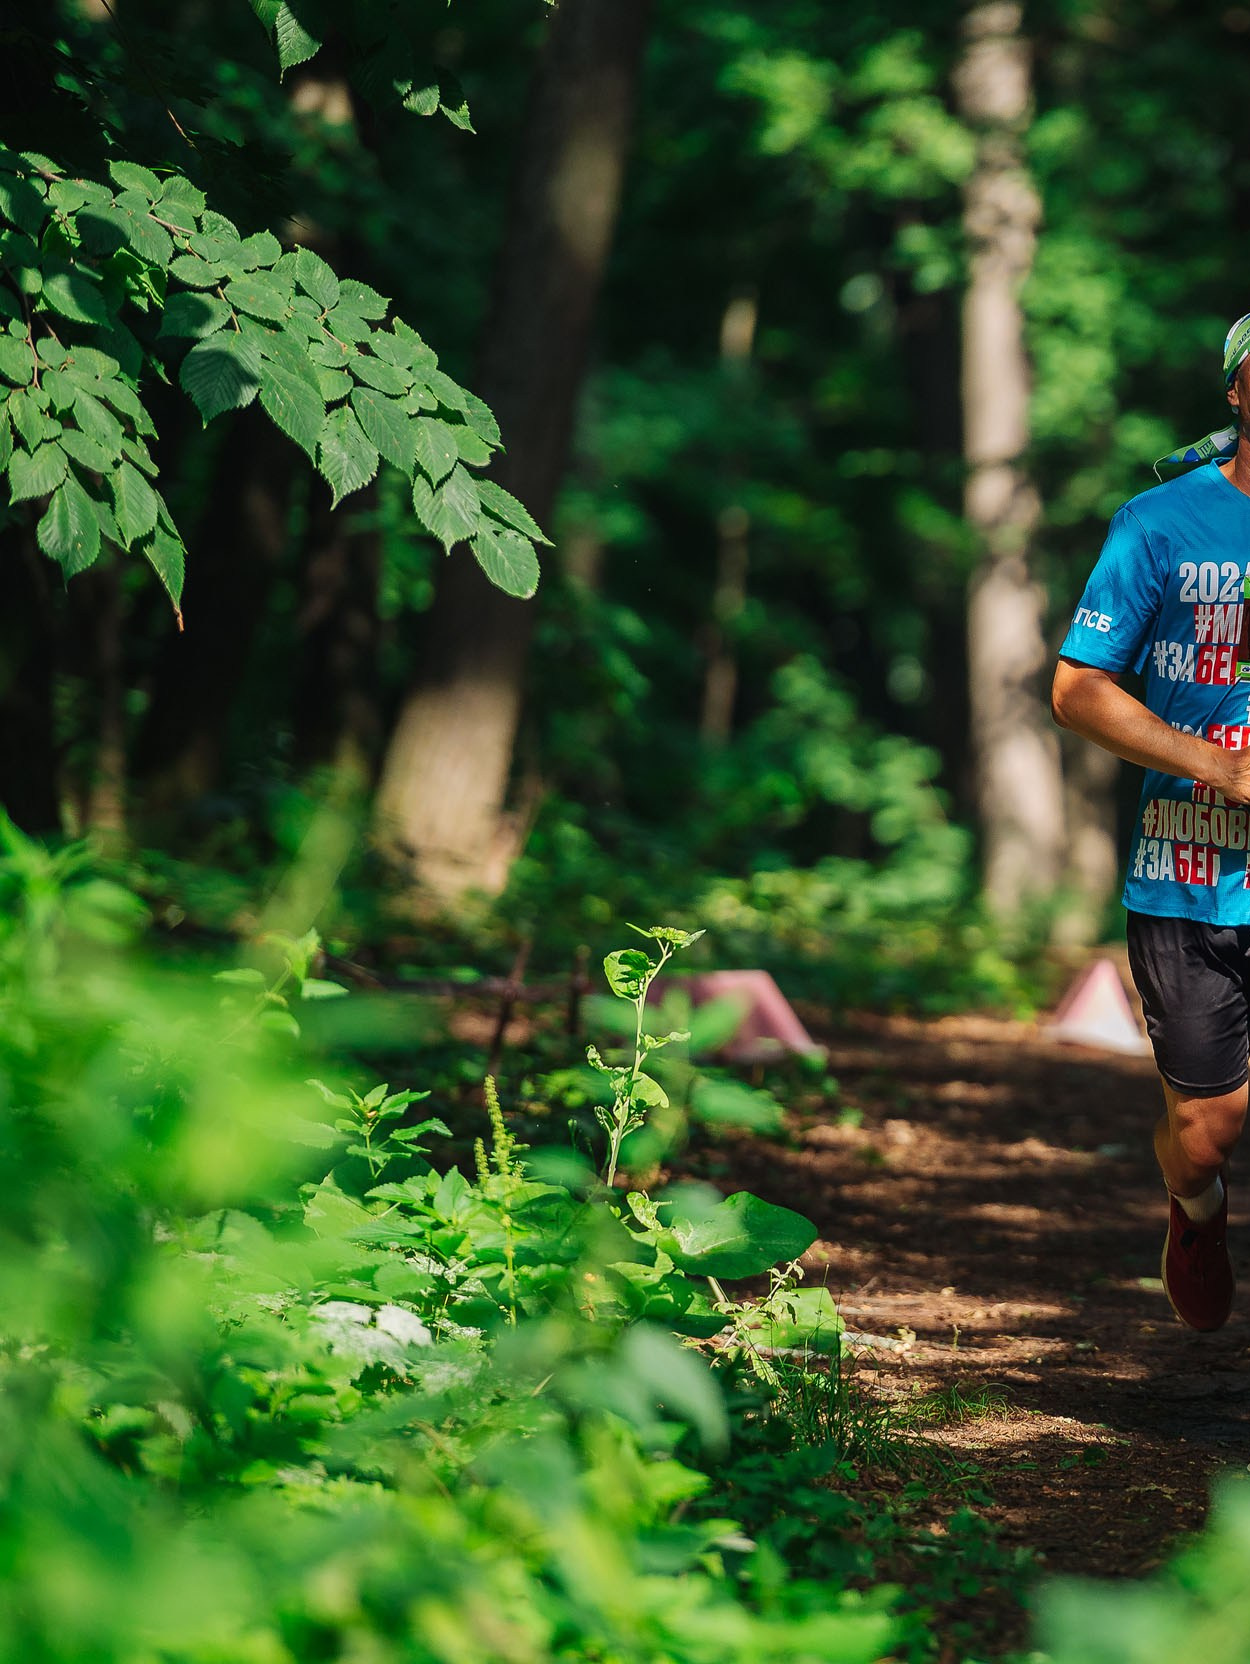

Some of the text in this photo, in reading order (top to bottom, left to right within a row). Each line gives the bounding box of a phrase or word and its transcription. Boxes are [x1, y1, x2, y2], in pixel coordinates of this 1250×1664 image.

[1074, 607, 1113, 633] ПСБ
[1194, 604, 1244, 644] #М
[1133, 838, 1221, 887] #ЗАБЕГ
